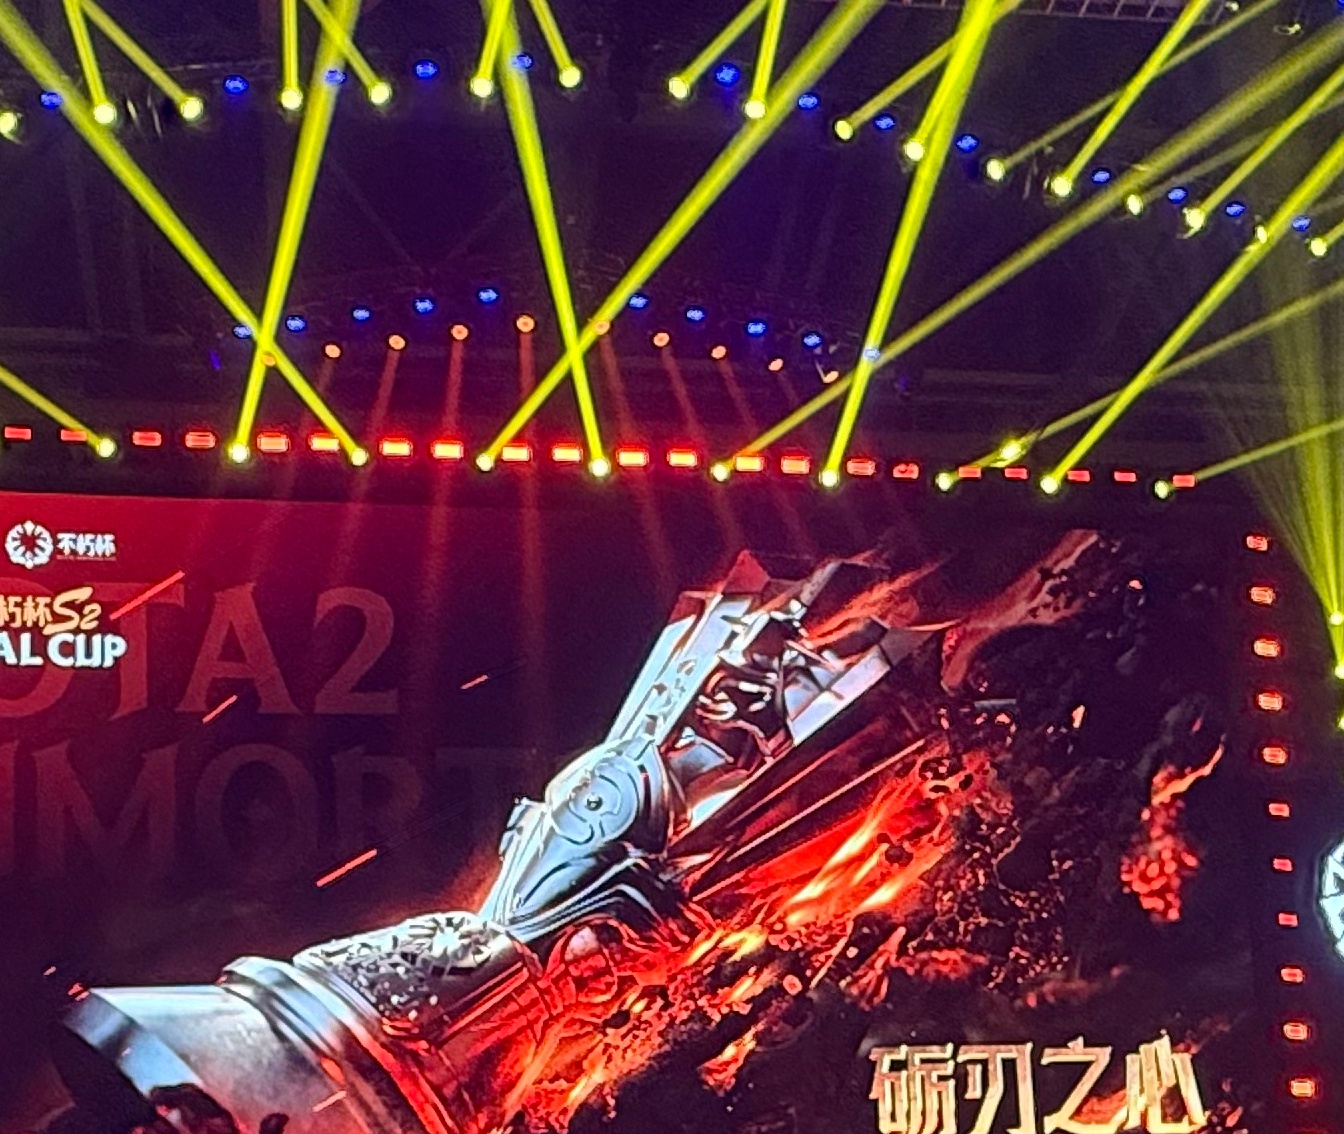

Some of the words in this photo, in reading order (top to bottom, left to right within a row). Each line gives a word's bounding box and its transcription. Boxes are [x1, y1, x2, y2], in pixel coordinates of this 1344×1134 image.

[56, 532, 116, 557] 不朽杯
[47, 632, 128, 668] CUP
